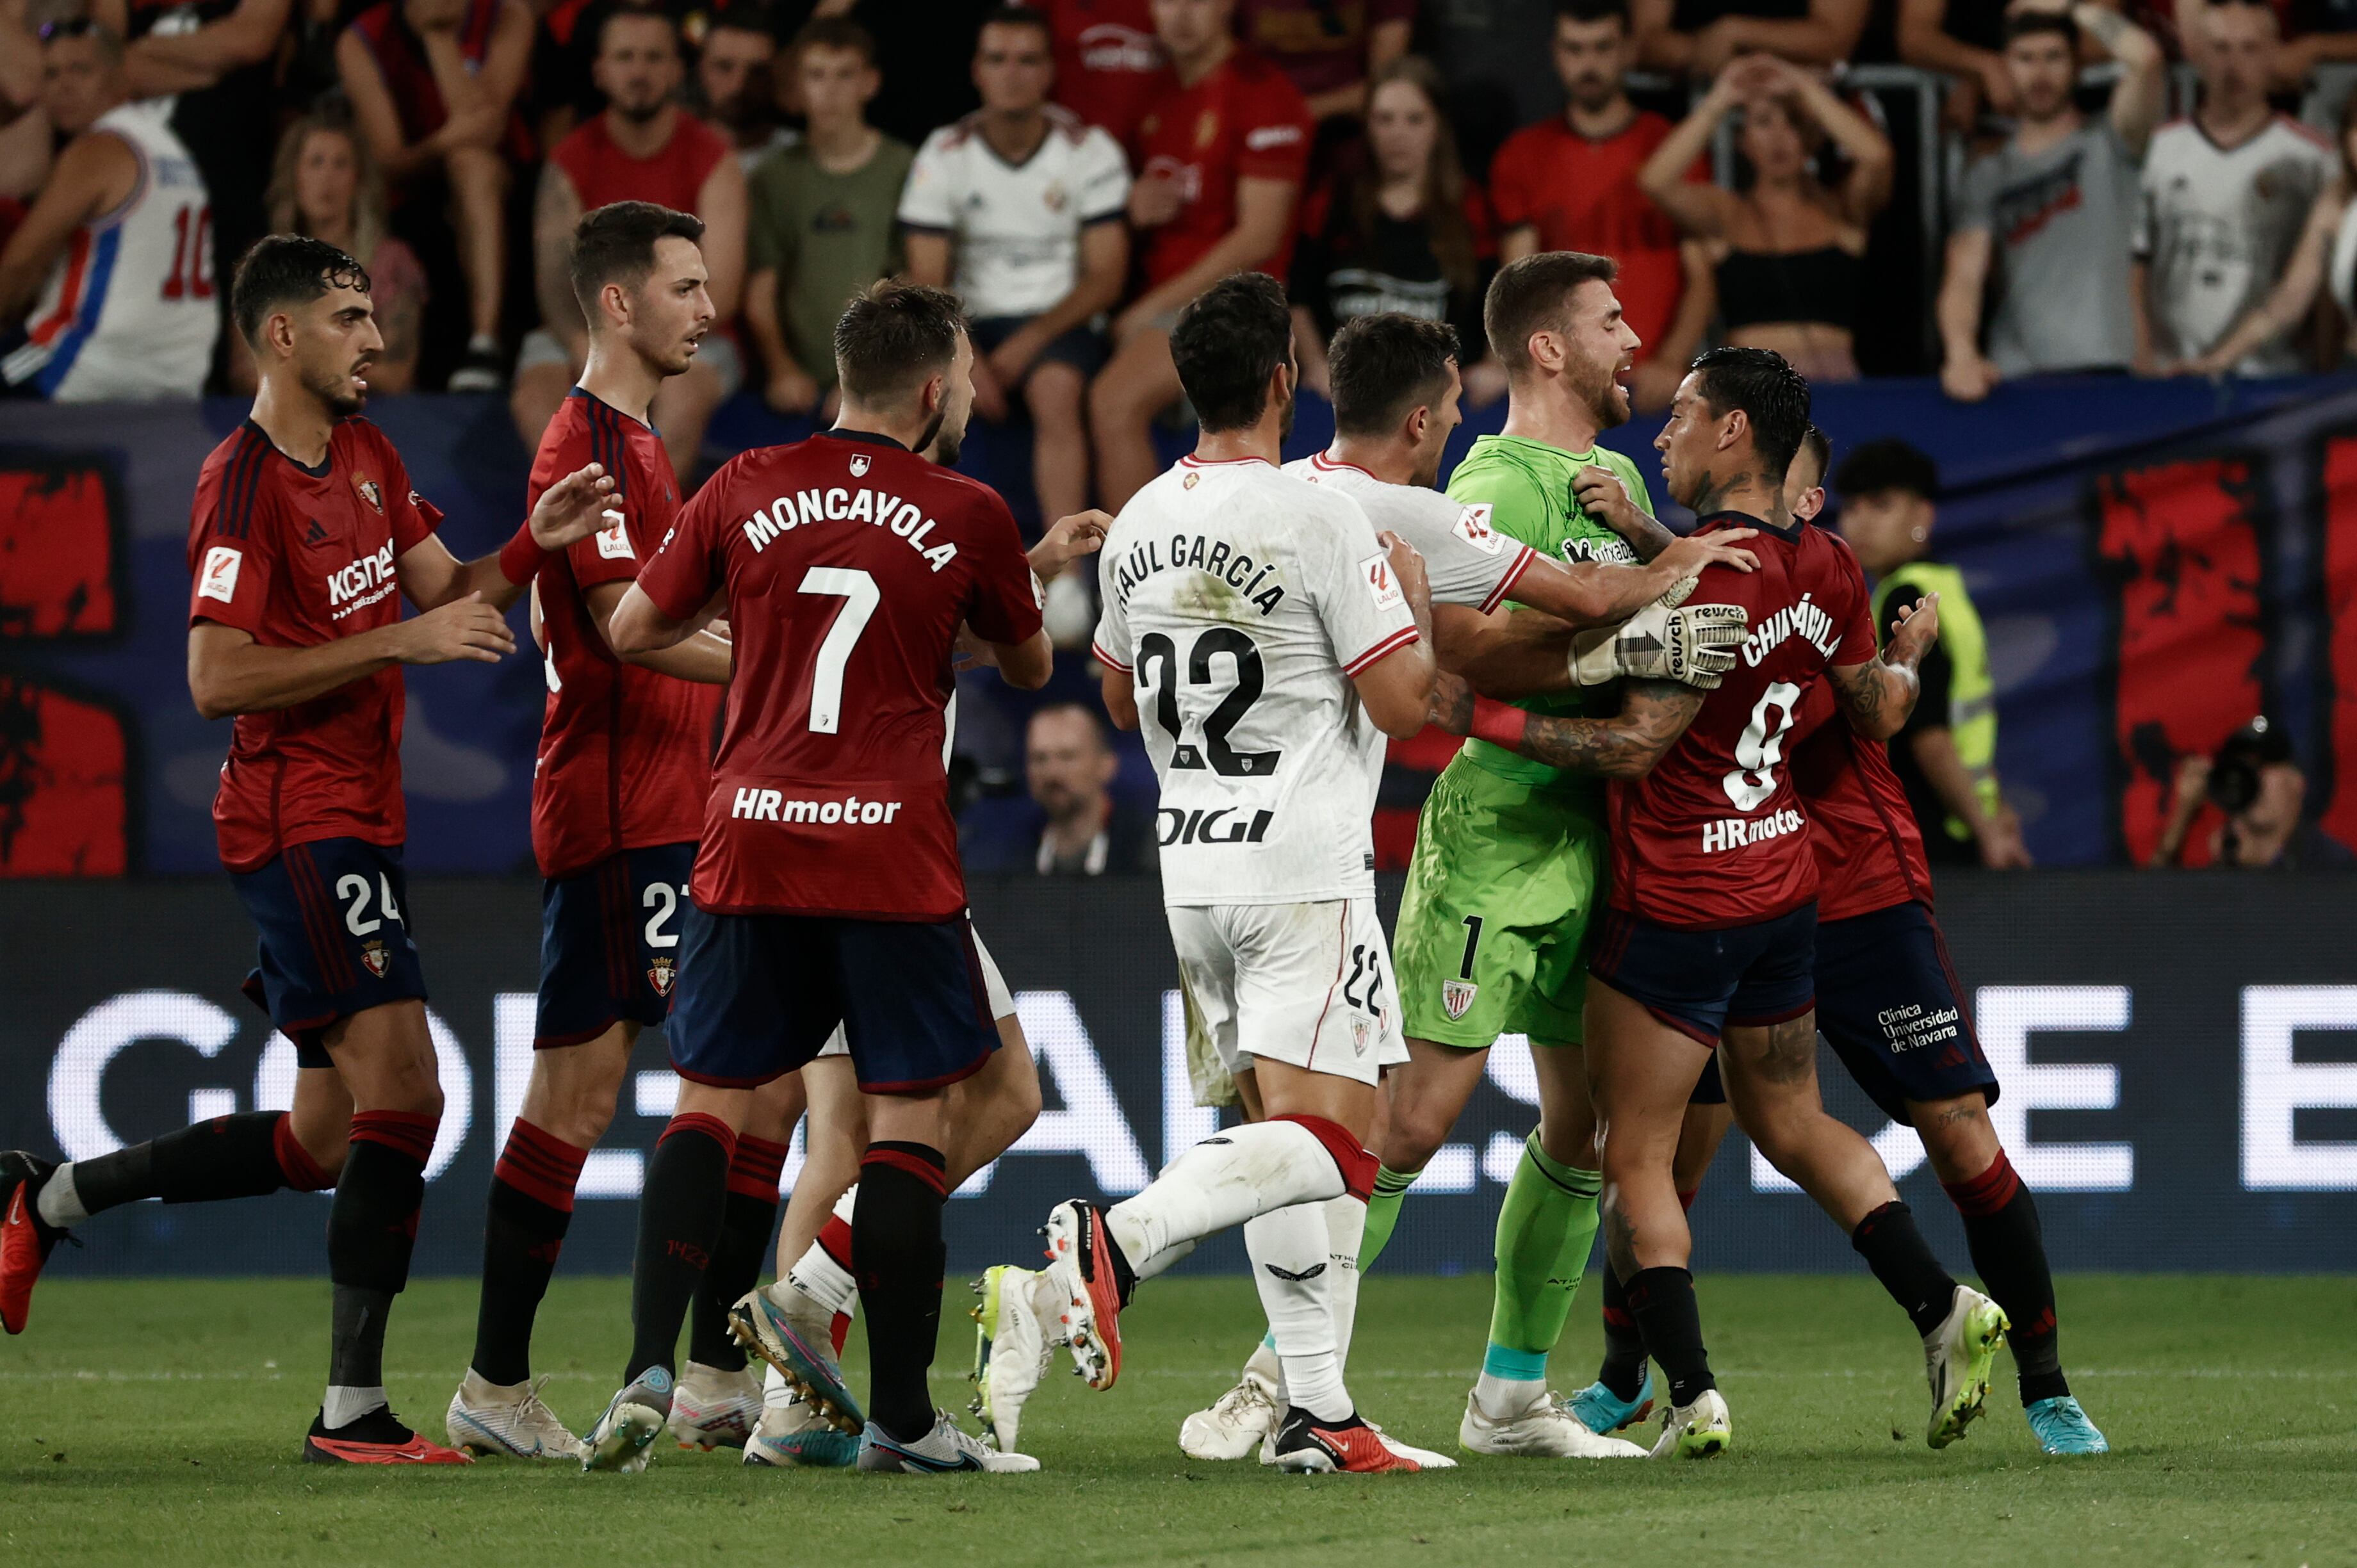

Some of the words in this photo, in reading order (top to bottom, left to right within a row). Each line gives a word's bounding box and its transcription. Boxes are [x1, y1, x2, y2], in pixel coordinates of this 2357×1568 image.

[742, 487, 958, 573] MONCAYOLA
[1171, 534, 1286, 617] GARCÍA
[1377, 590, 1398, 604] LALIG
[1668, 616, 1683, 675] reusch
[1694, 607, 1744, 619] reusch
[797, 566, 881, 735] 7
[1136, 627, 1281, 776] 22
[1723, 682, 1801, 812] 9
[1158, 807, 1274, 846] DIGI
[643, 882, 689, 948] 2
[1461, 915, 1483, 980] 1
[1344, 944, 1382, 1017] 22
[1878, 1003, 1921, 1026] Clínica
[1884, 1006, 1959, 1039] Universidad
[1891, 1039, 1907, 1054] de
[1910, 1025, 1958, 1049] Navarra
